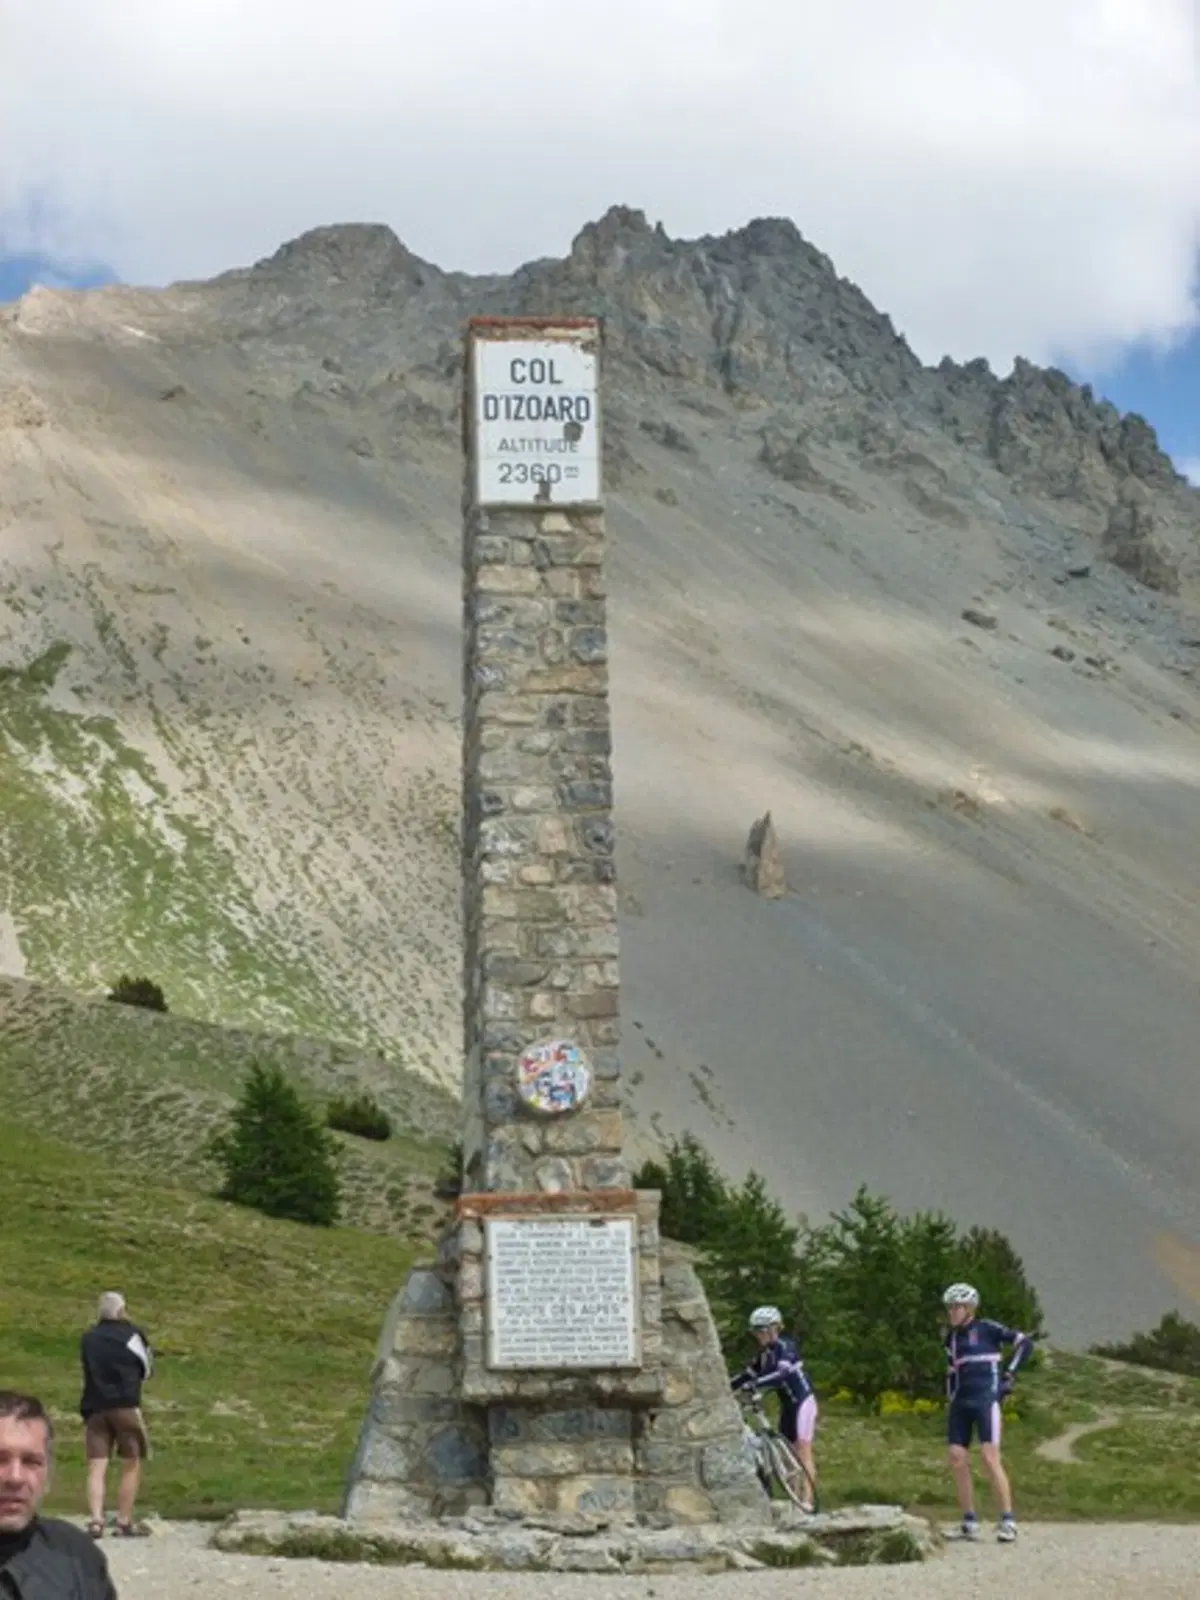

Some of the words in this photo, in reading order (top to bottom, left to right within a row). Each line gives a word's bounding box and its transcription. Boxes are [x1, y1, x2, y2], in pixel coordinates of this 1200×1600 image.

[510, 357, 563, 385] COL
[483, 394, 591, 422] D'IZOARD
[497, 437, 579, 454] ALTITUDE
